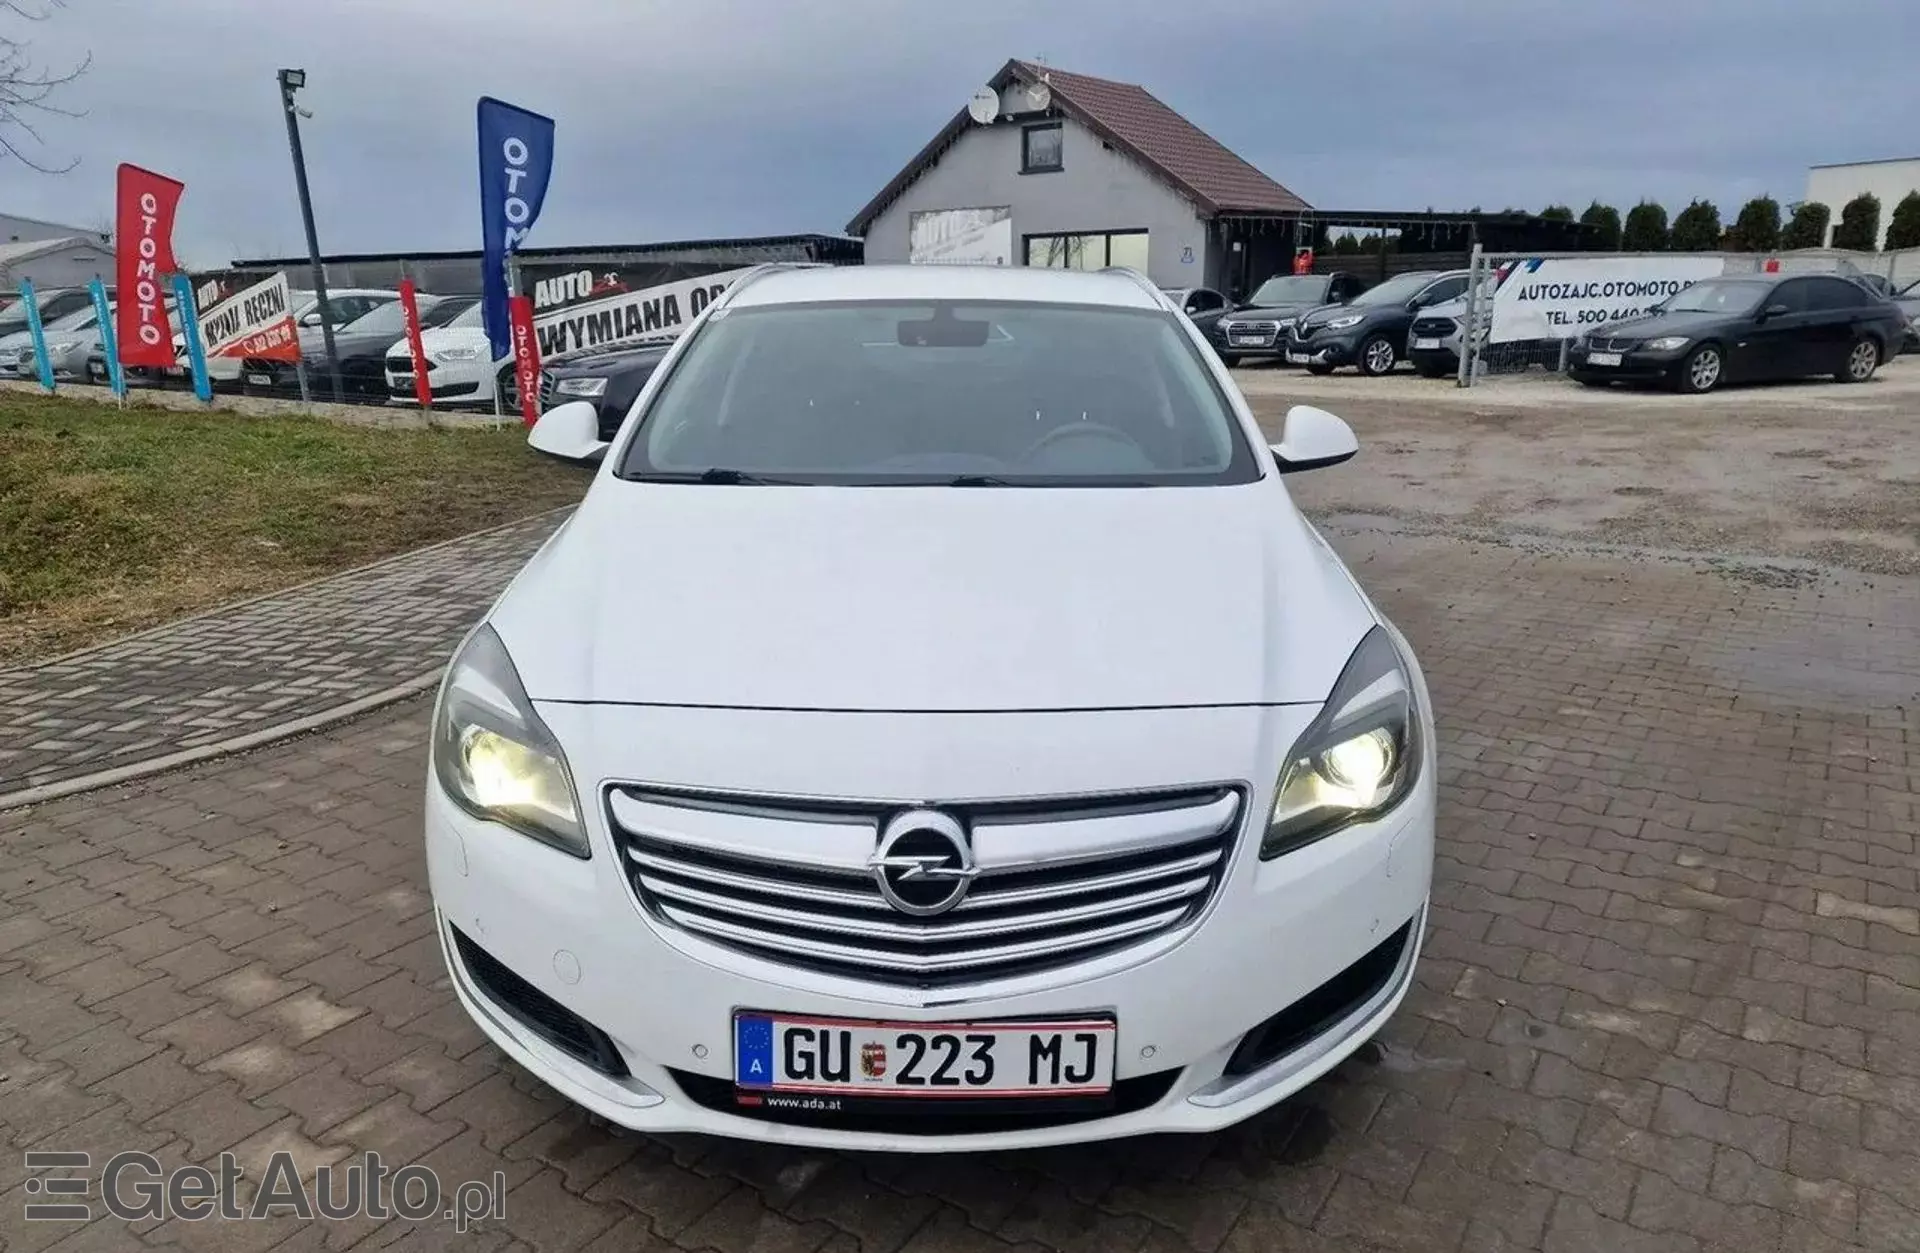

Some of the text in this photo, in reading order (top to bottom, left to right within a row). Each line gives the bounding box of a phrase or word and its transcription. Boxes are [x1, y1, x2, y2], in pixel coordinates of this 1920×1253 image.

[503, 137, 529, 250] OTOM
[136, 193, 160, 345] OTOMOTO
[534, 270, 593, 308] AUTO
[538, 294, 682, 357] WYMIANA
[1546, 311, 1573, 325] TEL.
[1577, 309, 1607, 323] 500
[516, 325, 535, 402] OTOMOTO
[750, 1058, 763, 1074] A
[783, 1027, 1098, 1087] GU 223 MJ
[767, 1097, 842, 1111] www.ada.at
